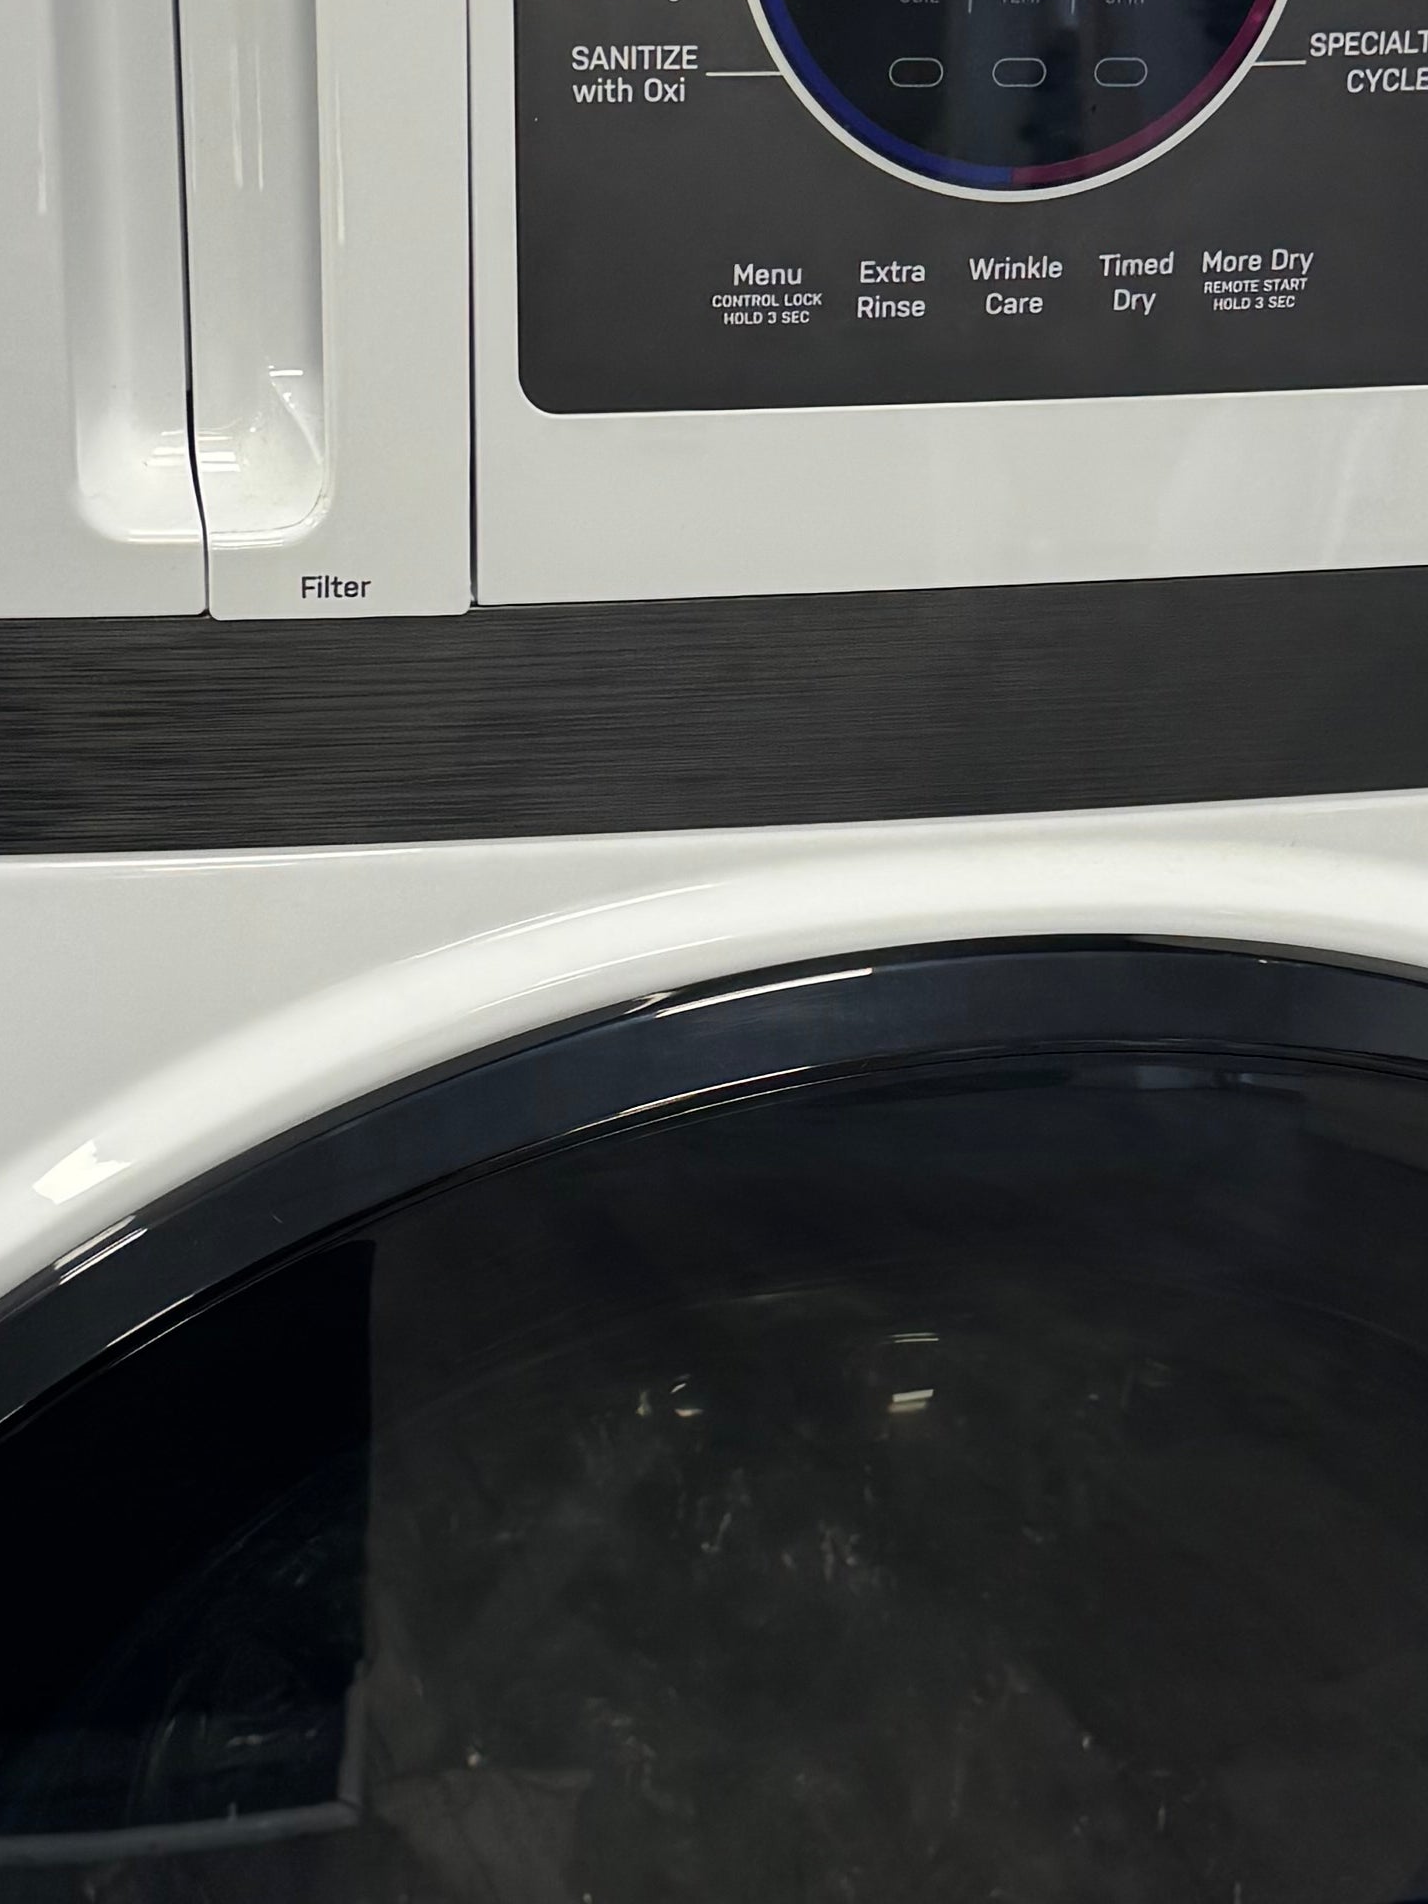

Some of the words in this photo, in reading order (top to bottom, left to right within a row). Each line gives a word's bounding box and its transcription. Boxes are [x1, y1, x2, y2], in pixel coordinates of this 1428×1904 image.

[571, 44, 699, 71] SANITIZE
[572, 76, 634, 103] with
[643, 76, 687, 103] Oxi
[733, 262, 803, 286] Menu
[859, 260, 927, 284] Extra
[968, 255, 1064, 281] Wrinkle
[1098, 251, 1175, 277] Timed
[1201, 250, 1263, 274] More
[1270, 247, 1315, 276] Dry
[1203, 278, 1260, 294] REMOTE
[1262, 277, 1309, 292] START
[711, 293, 780, 309] CONTROL
[783, 292, 823, 308] LOCK
[856, 295, 927, 320] Rinse
[985, 292, 1044, 316] Care
[1112, 288, 1157, 317] Dry
[1212, 297, 1251, 312] HOLD
[1254, 296, 1265, 310] 3
[1267, 295, 1296, 309] SEC
[723, 311, 763, 326] HOLD
[767, 310, 778, 325] 3
[781, 310, 811, 325] SEC
[301, 574, 372, 599] Filter
